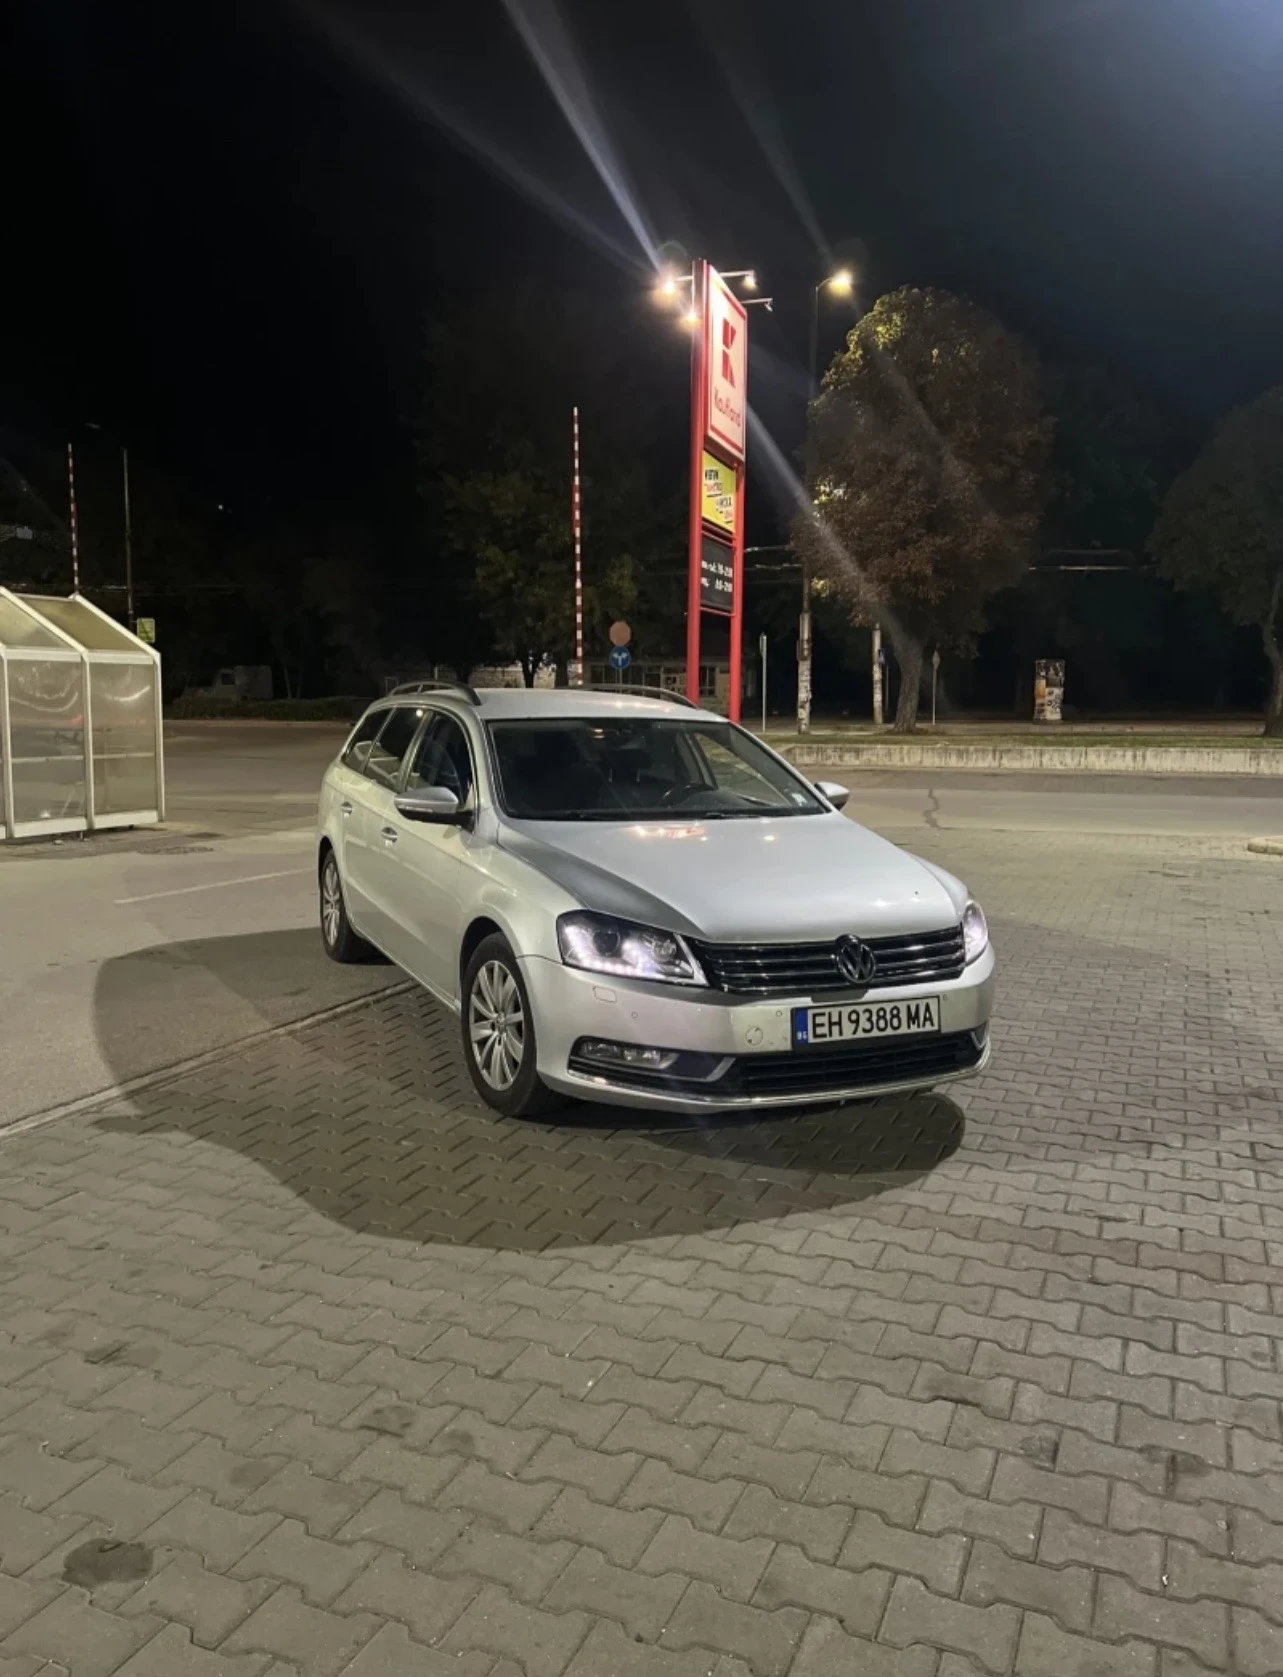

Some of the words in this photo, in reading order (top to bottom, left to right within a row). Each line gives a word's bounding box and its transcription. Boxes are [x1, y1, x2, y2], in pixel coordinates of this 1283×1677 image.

[812, 1010, 843, 1039] EH
[847, 1005, 902, 1035] 9388
[906, 1001, 935, 1030] MA
